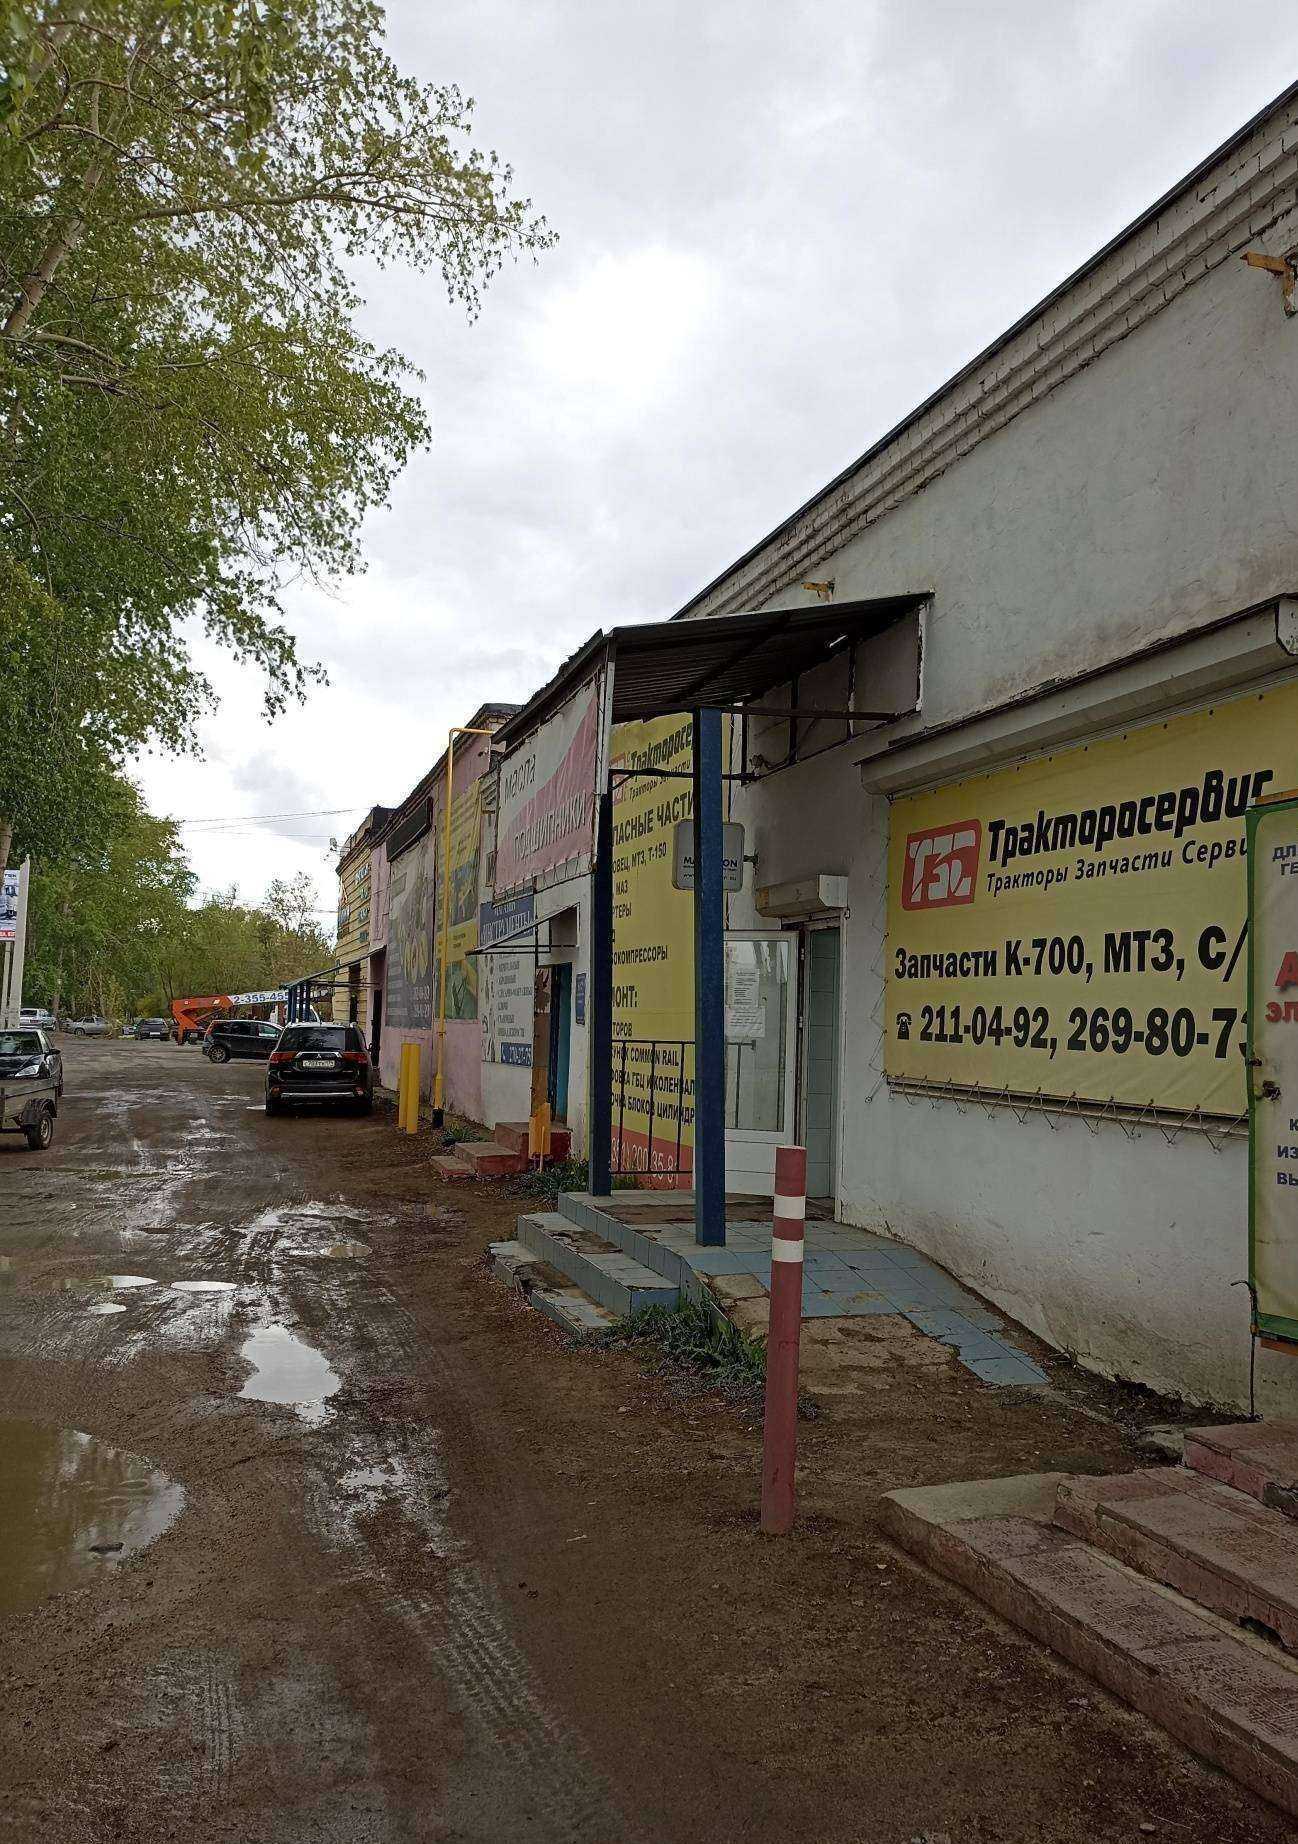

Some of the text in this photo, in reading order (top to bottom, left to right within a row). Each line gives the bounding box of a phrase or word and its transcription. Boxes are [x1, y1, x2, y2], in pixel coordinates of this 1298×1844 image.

[629, 722, 693, 783] Тракторосе
[612, 808, 654, 847] ПАСНЫЕ
[612, 855, 631, 874] ОВЕЦ,
[648, 841, 667, 862] Т-150
[986, 864, 1068, 897] Тракторы
[1075, 850, 1172, 881] Запчасти
[612, 945, 668, 966] ОКОМПРЕССОРЫ
[895, 916, 1249, 984] Запчасти К-700, МТЗ, С/
[613, 985, 638, 1008] ОНТ:
[612, 1021, 633, 1038] ТОРОВ
[919, 1005, 1058, 1060] 211-04-92,
[662, 1049, 680, 1067] RAIL
[631, 1072, 645, 1092] ГБЦ
[653, 1075, 695, 1096] КОЛЕНАЛ
[656, 1102, 695, 1127] ЦИЛИДР
